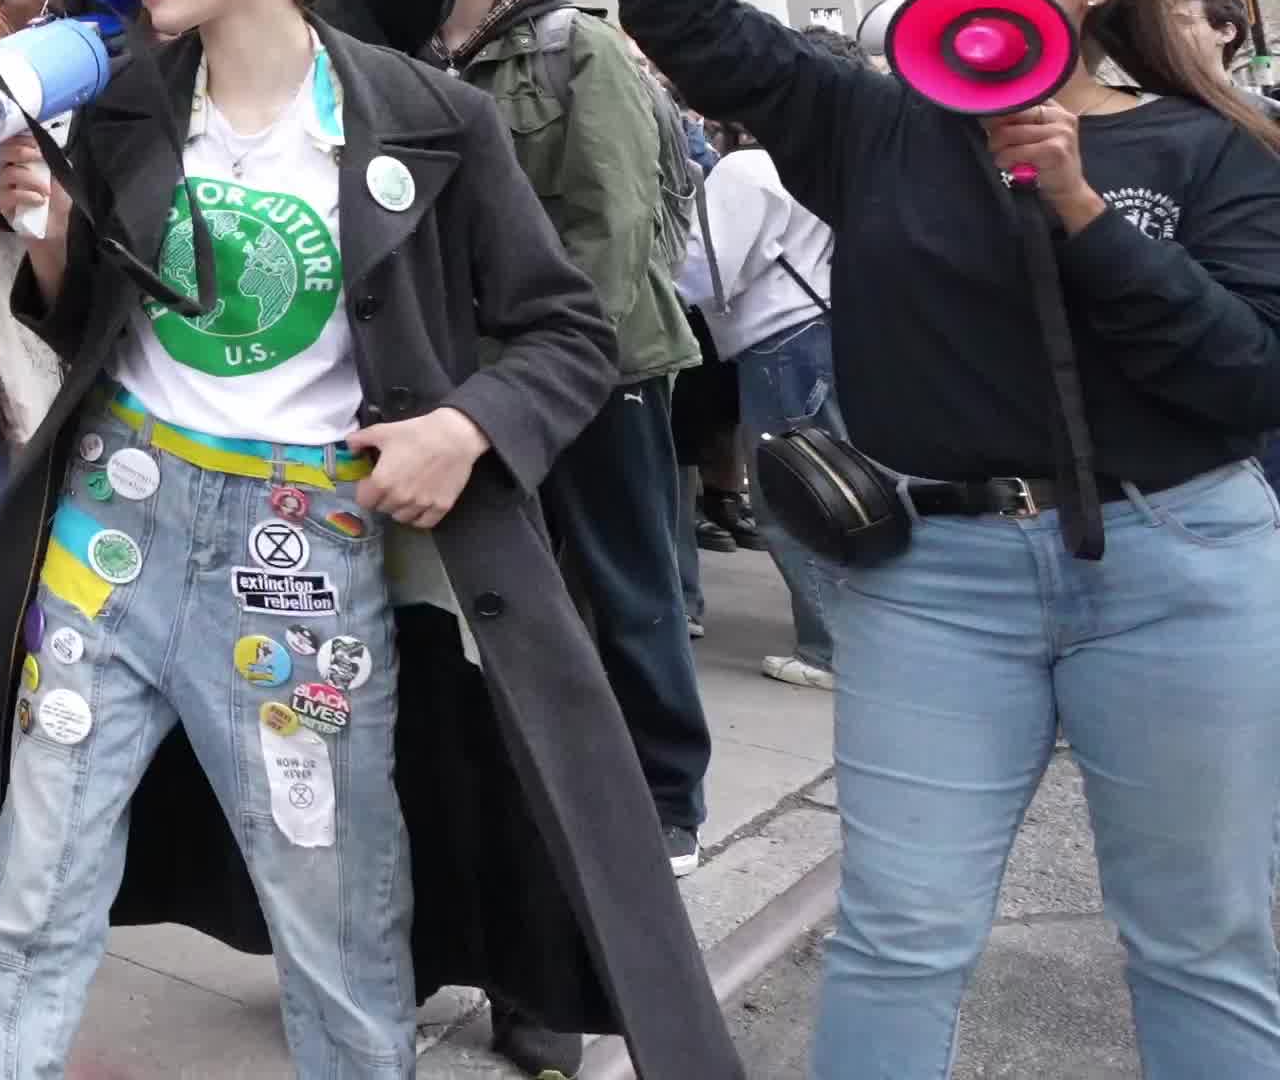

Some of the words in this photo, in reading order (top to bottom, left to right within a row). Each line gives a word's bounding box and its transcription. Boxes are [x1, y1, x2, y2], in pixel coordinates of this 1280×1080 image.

[195, 182, 247, 206] OR
[252, 196, 334, 292] FUTURE
[225, 342, 278, 366] U.S.
[239, 573, 313, 593] extinction
[263, 592, 332, 610] rebellion
[292, 696, 347, 726] LIVES
[294, 684, 350, 713] BLACK
